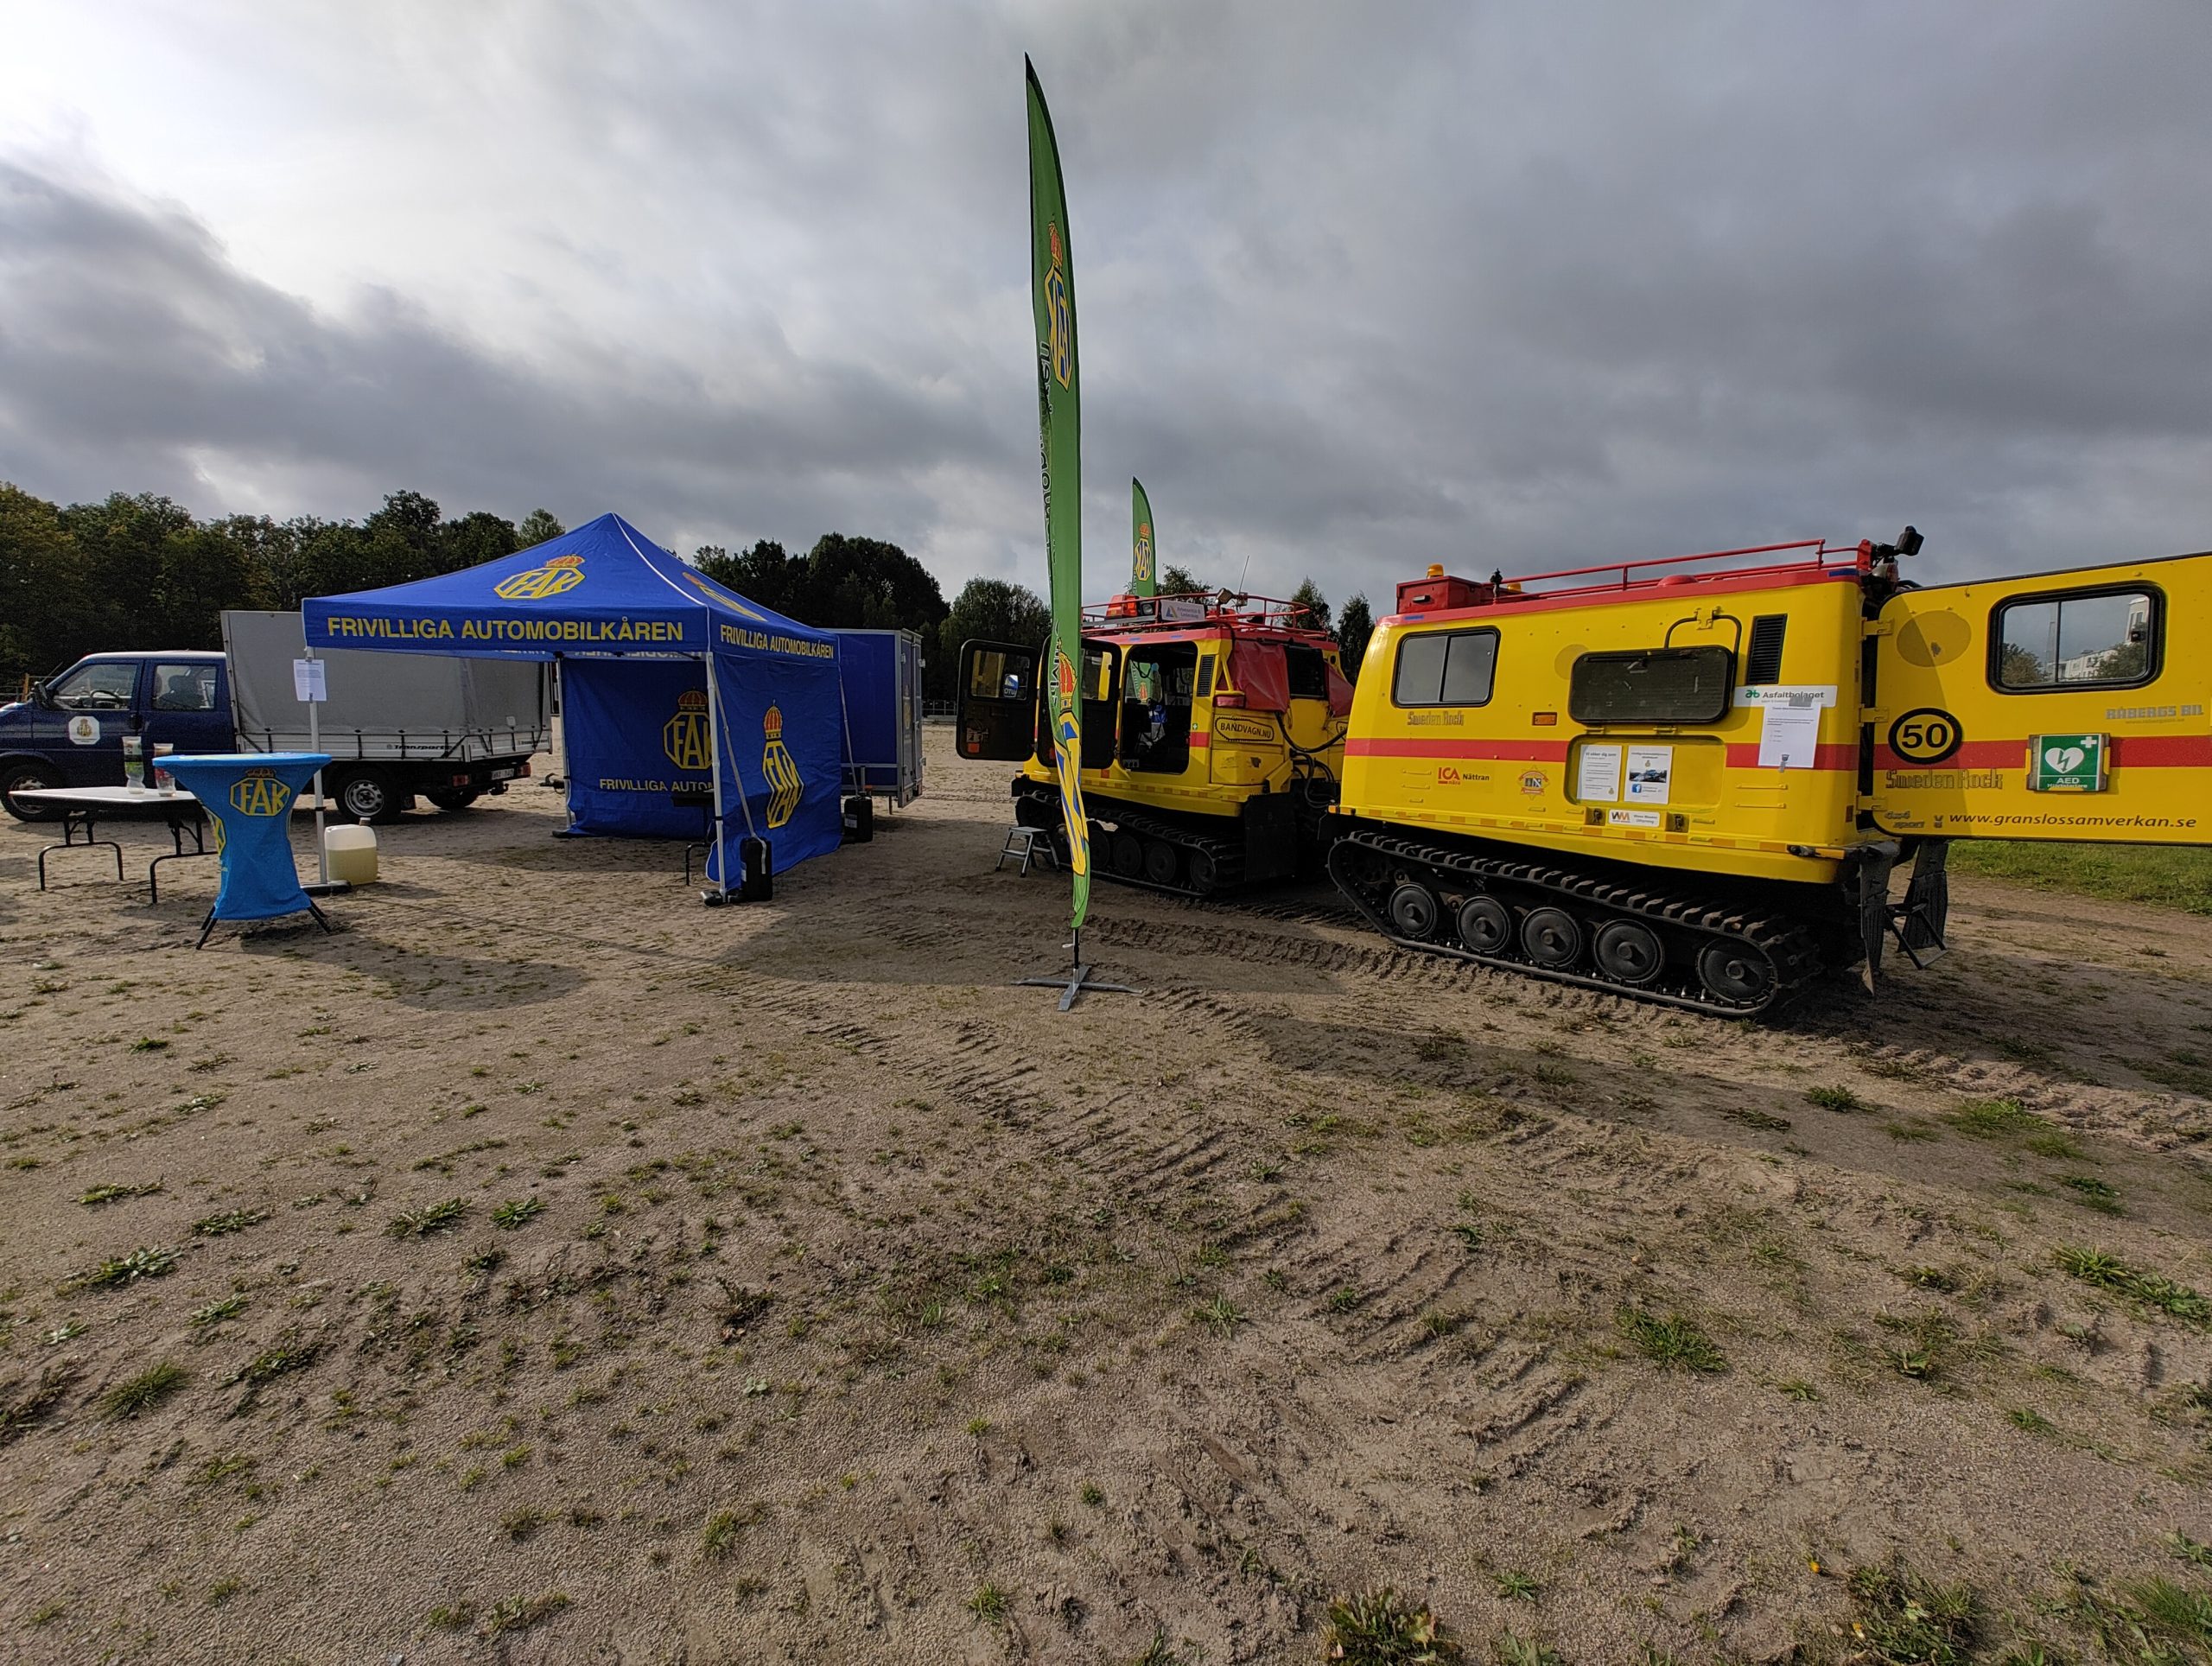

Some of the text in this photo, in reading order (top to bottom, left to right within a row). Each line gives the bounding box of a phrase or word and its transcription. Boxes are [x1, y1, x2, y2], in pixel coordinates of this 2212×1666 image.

[327, 616, 683, 641] FRIVILLIGA AUTOMOBILKÅREN
[720, 624, 834, 659] FRIVILLIGA AUTOMOBILKÅREN
[1763, 691, 1825, 700] Asfaltbolaget
[1408, 711, 1441, 726] Sweden
[1220, 722, 1272, 739] BANDVAGN.NU
[1902, 723, 1948, 749] 50
[1438, 767, 1460, 780] ICA
[1885, 768, 2004, 790] Sweden Rock
[600, 779, 668, 792] FRIVILLIGA
[239, 778, 290, 816] FAK
[1949, 813, 2197, 828] www.granslossamverkan.se
